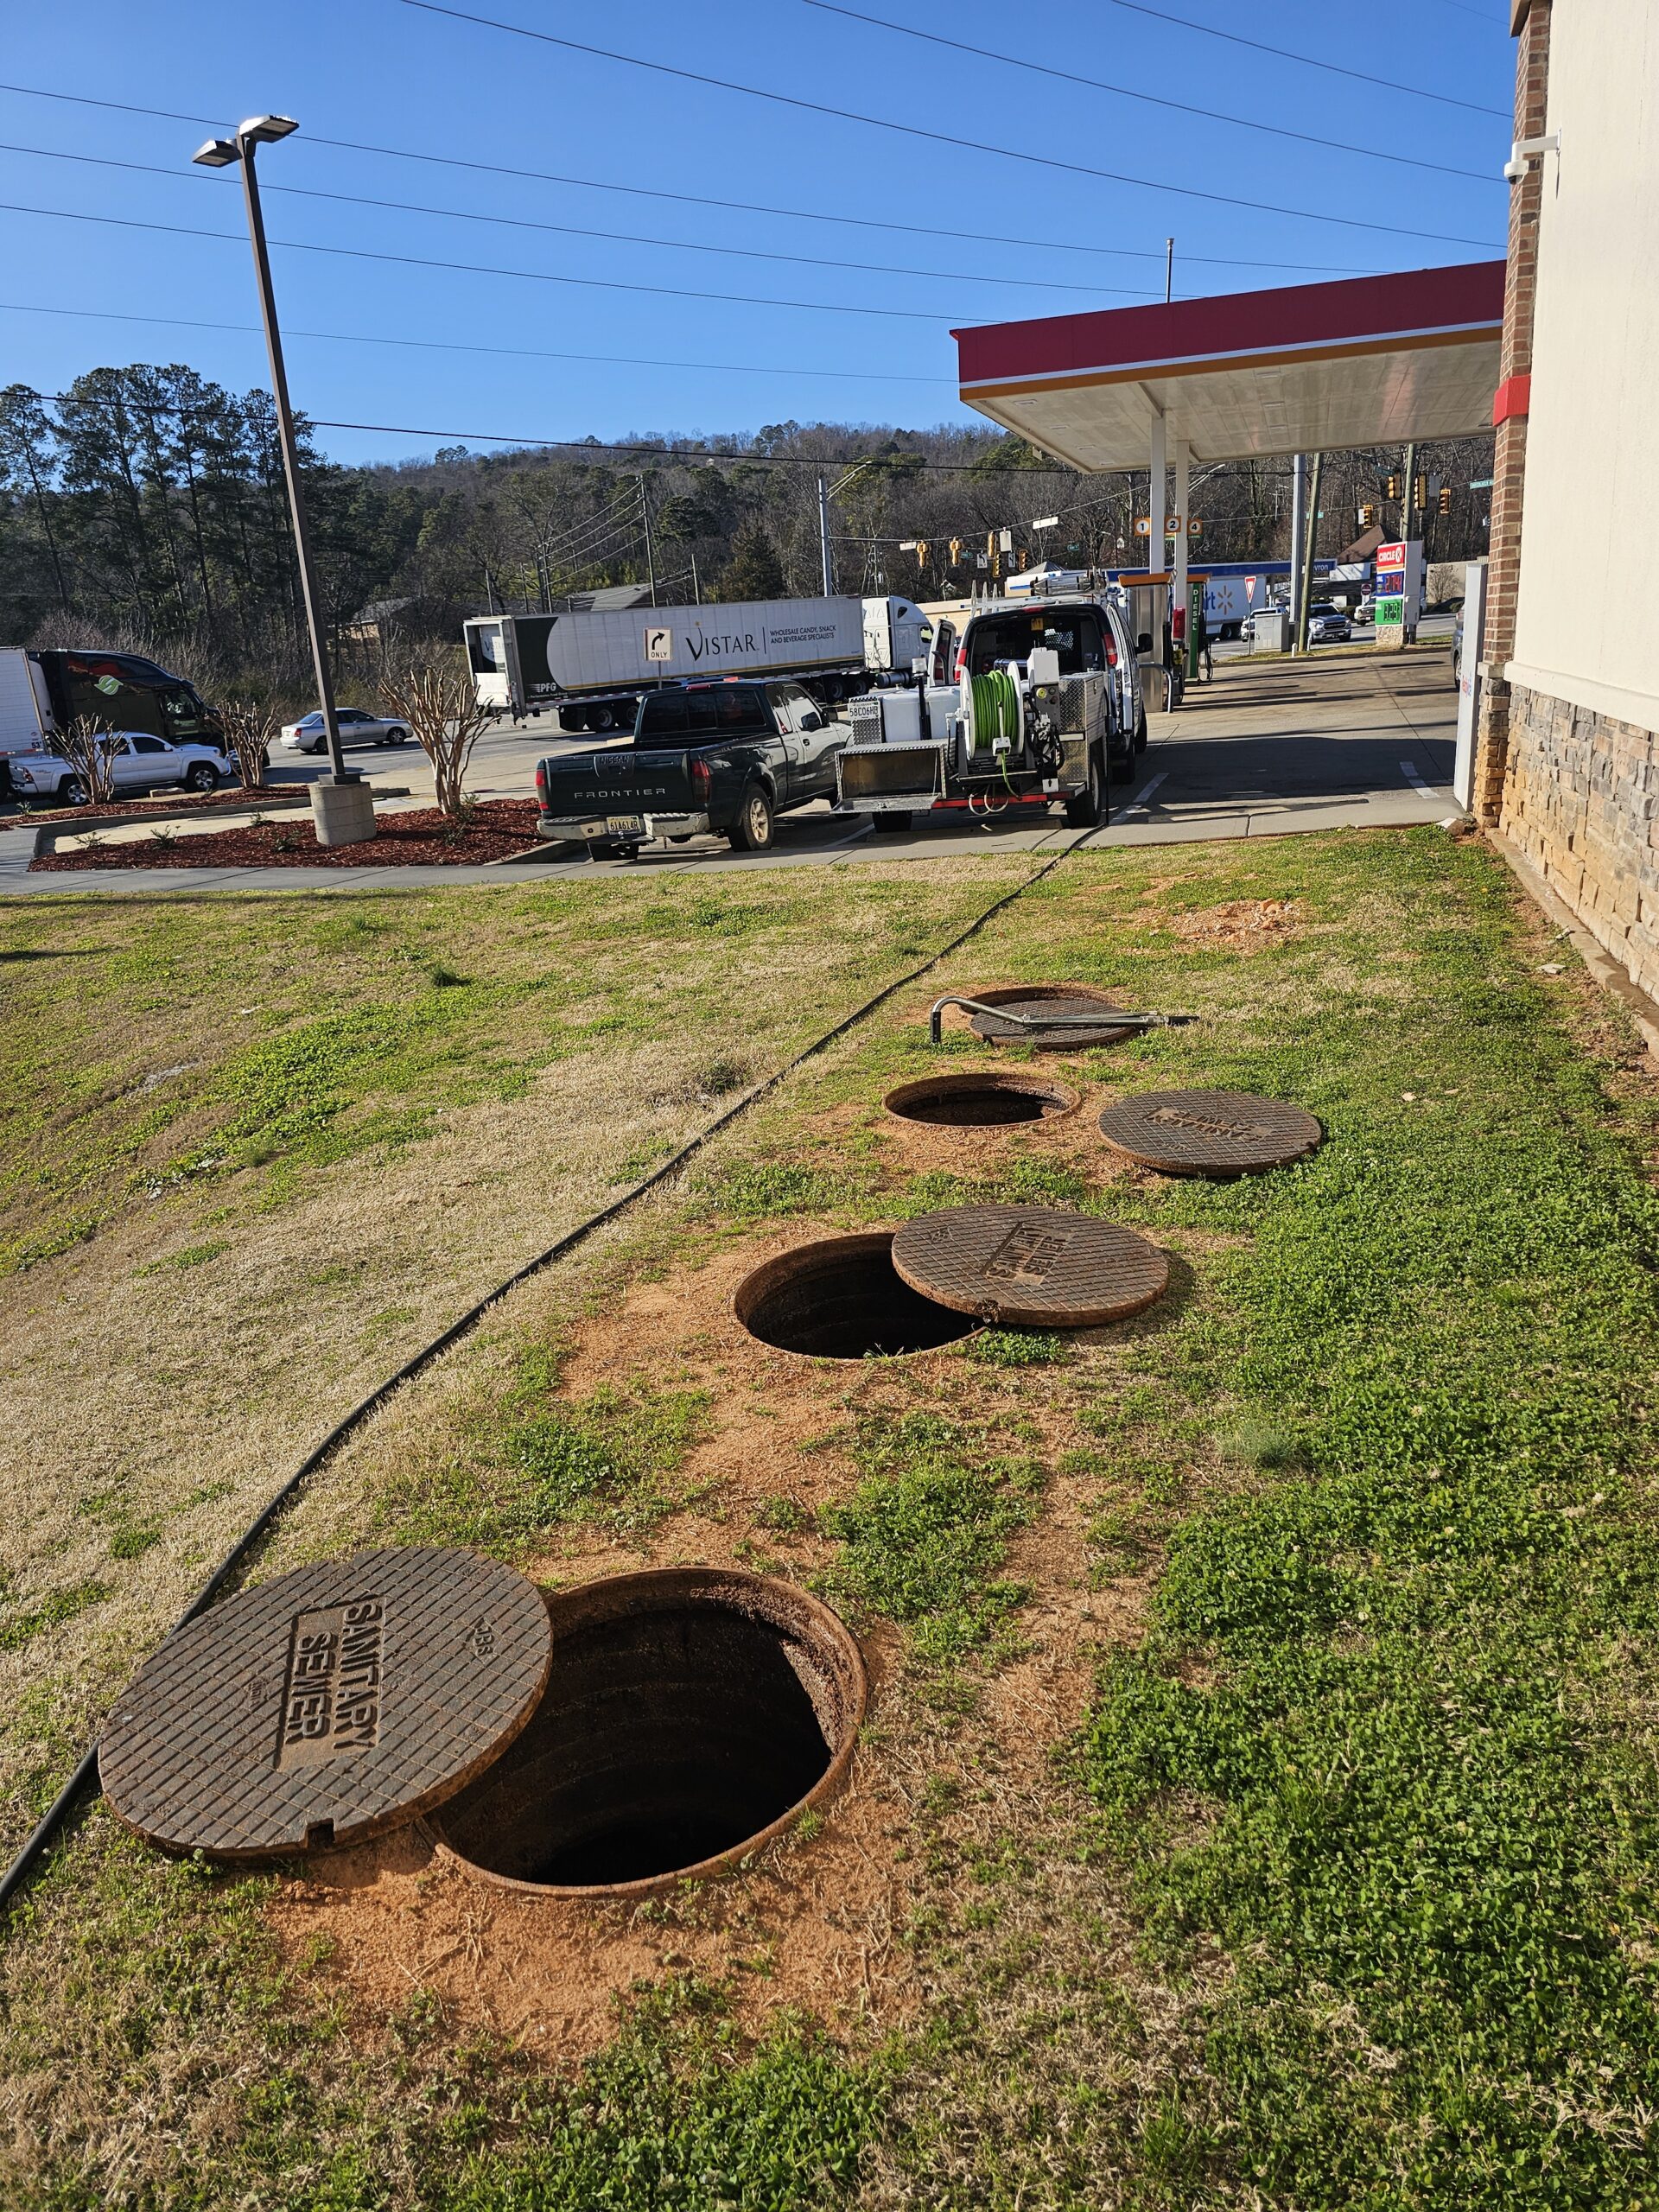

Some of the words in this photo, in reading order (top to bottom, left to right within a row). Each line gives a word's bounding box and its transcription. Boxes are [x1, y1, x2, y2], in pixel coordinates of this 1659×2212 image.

[1378, 550, 1395, 563] CIRCLE
[770, 627, 799, 637] WHOLESALE
[808, 632, 834, 640] SPECIALISTS
[685, 627, 757, 661] VISTAR
[540, 682, 556, 692] PFG
[601, 756, 630, 765] NISSAN
[574, 788, 665, 798] FRONTIER
[987, 1227, 1044, 1279] SANITARY
[1022, 1236, 1068, 1276] SEWER
[334, 1604, 383, 1750] SANITARY
[285, 1630, 339, 1745] SEWER
